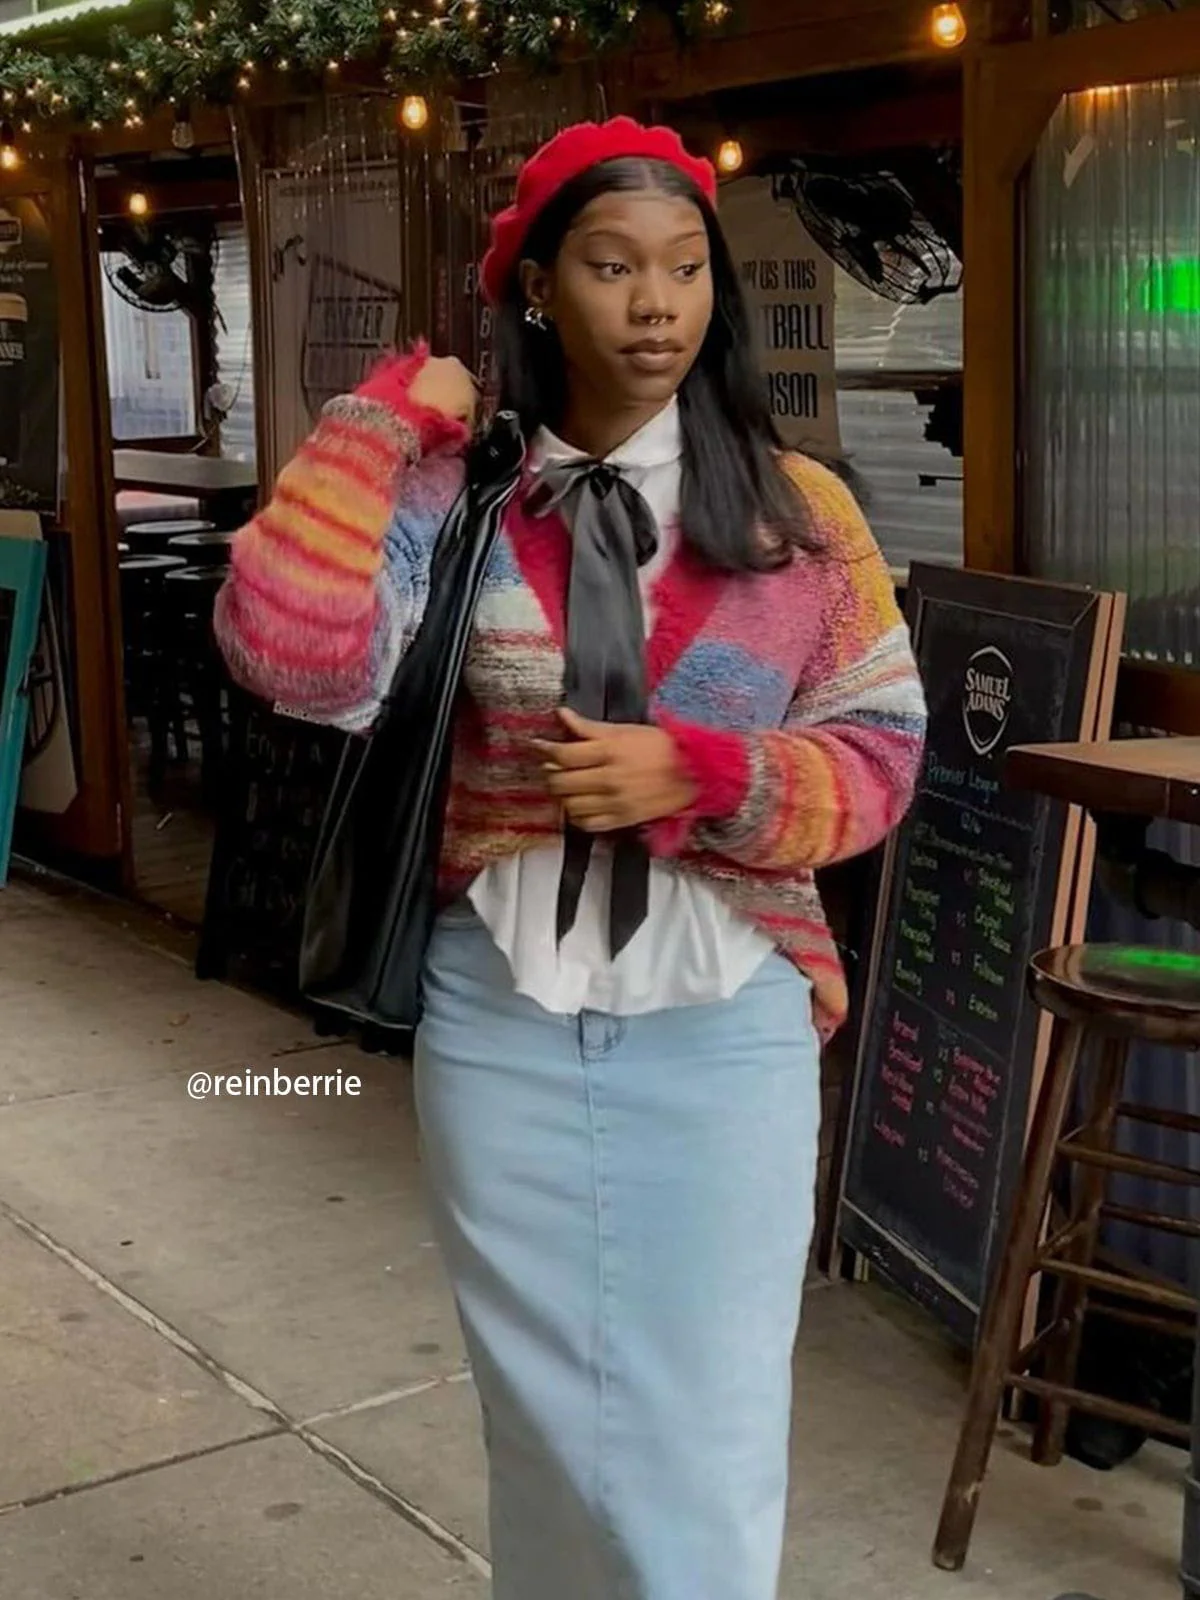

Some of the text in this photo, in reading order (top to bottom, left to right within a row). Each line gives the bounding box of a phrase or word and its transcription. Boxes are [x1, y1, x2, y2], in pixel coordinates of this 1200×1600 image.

[760, 259, 779, 290] US
[783, 259, 817, 290] THIS
[965, 667, 1011, 701] SAMUEL
[966, 692, 1006, 721] ADAMS
